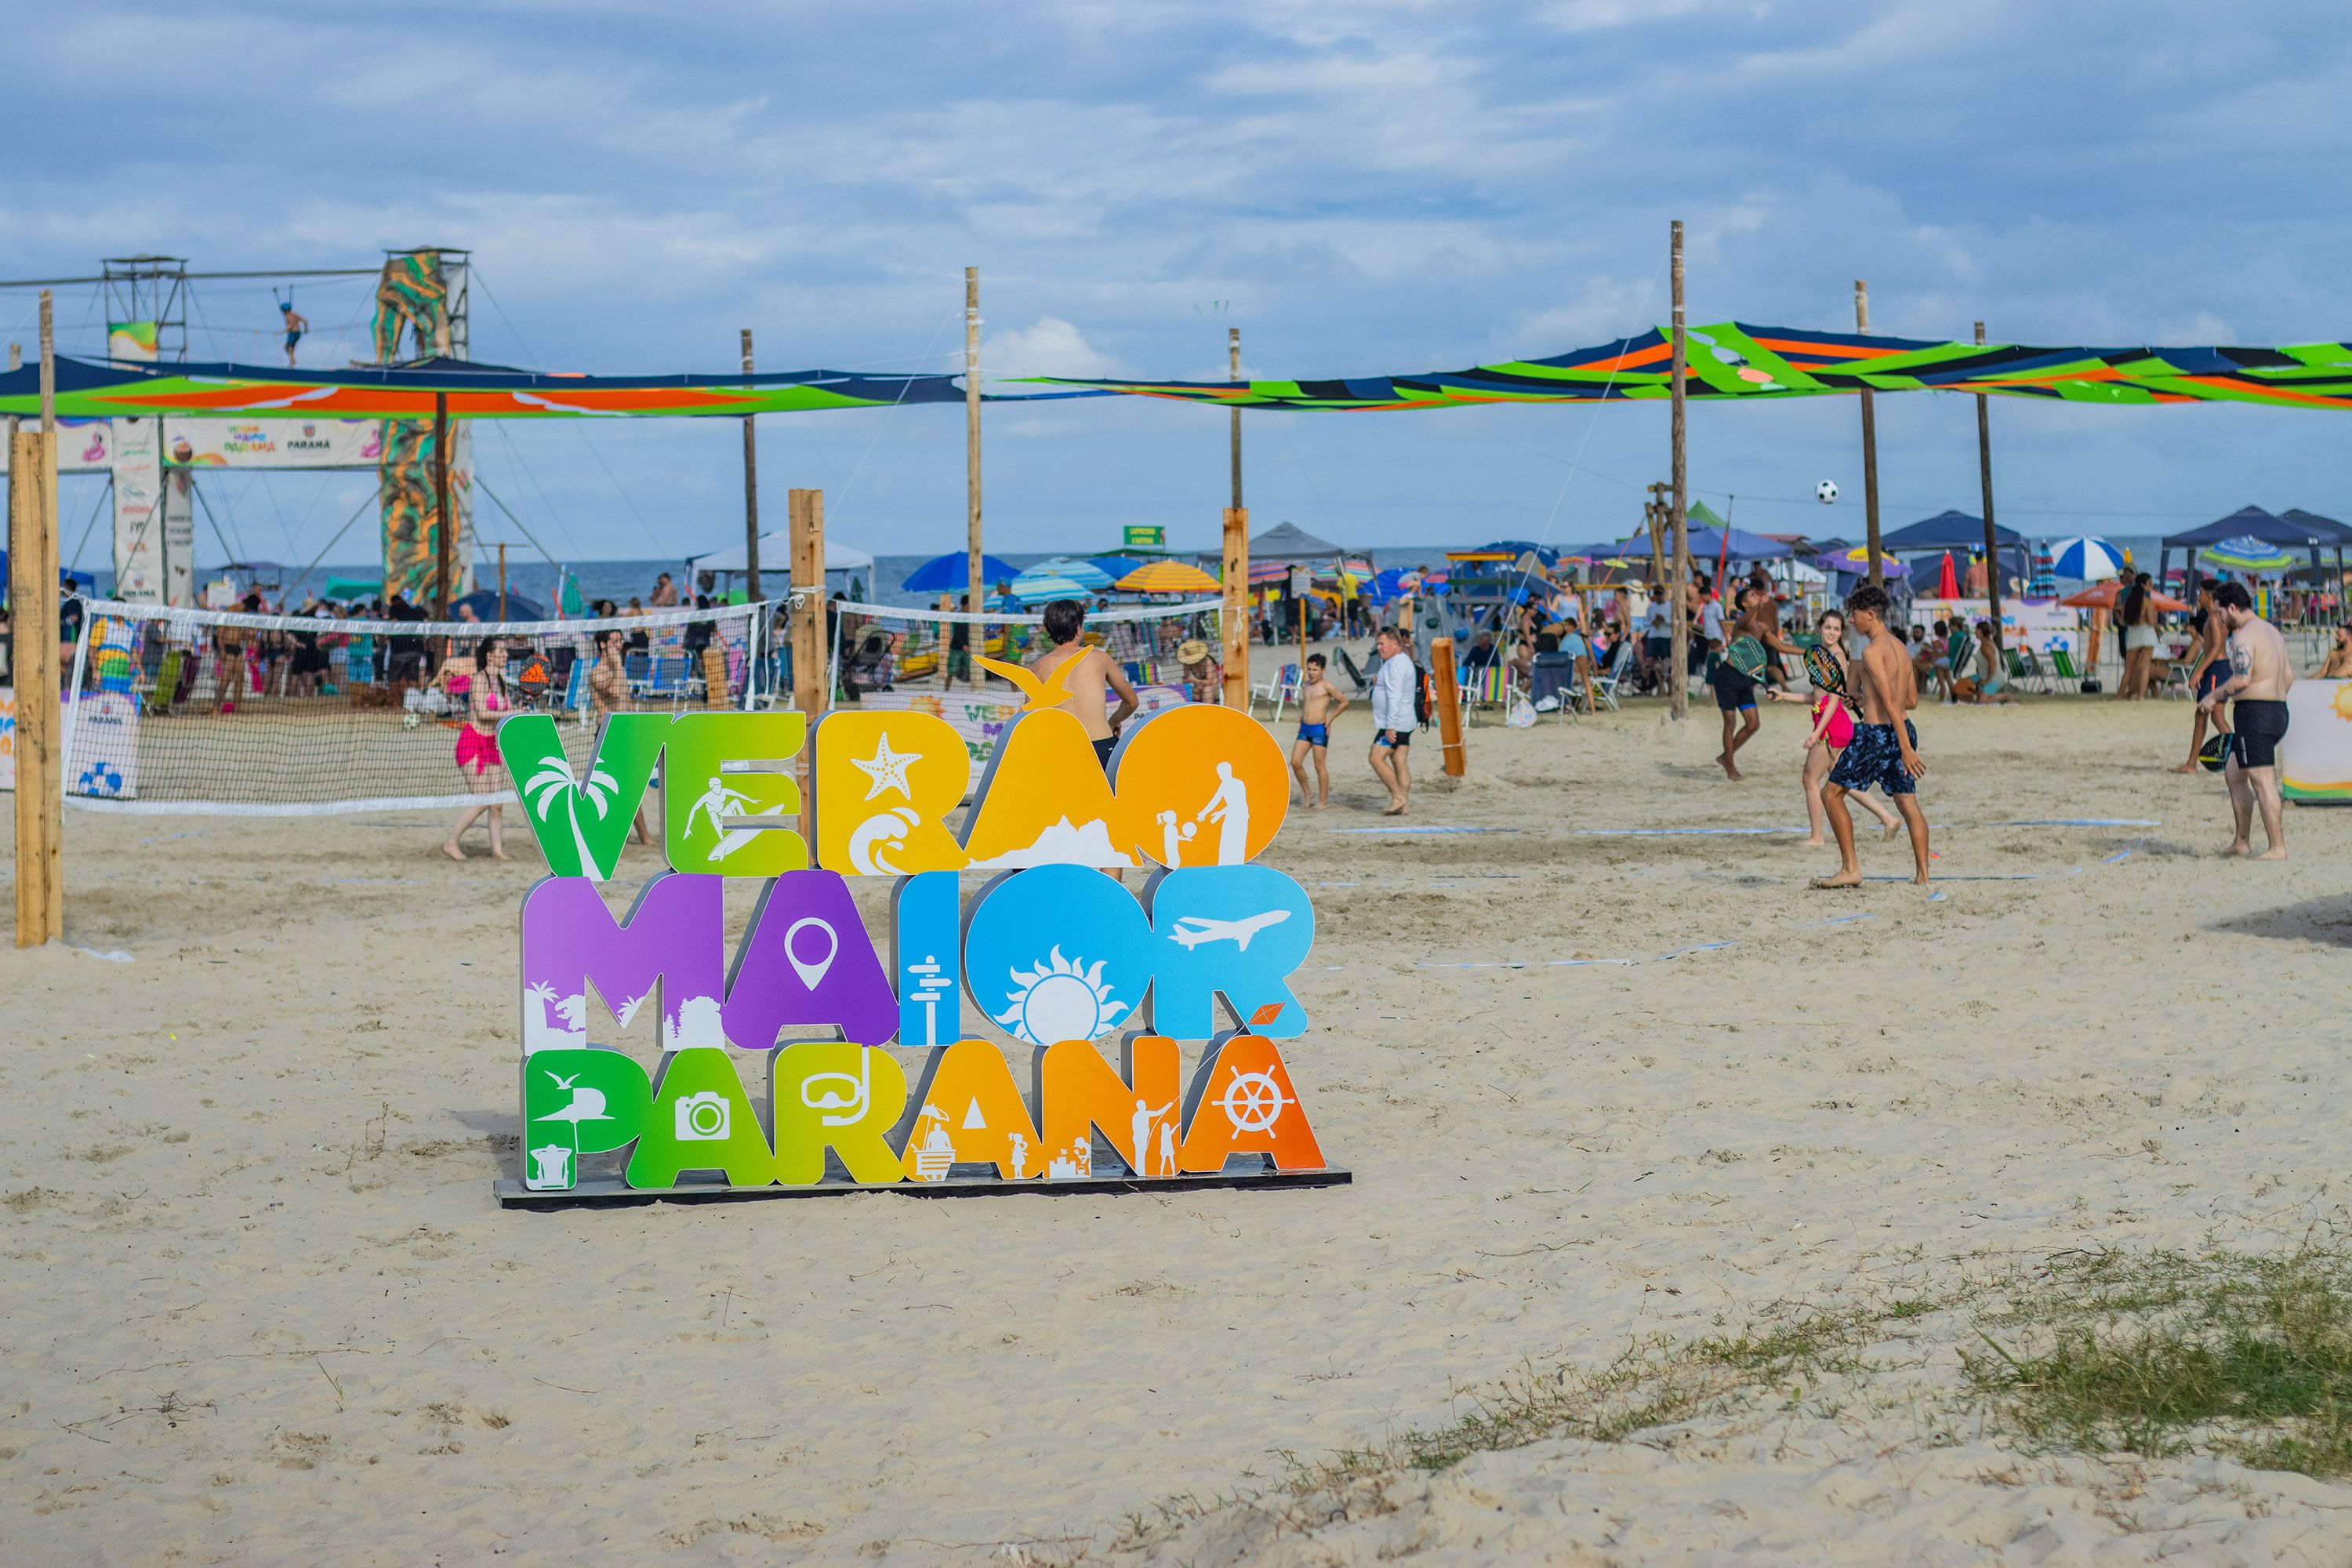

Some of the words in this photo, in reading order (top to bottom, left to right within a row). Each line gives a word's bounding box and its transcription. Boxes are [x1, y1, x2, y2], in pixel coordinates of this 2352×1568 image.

[287, 439, 330, 449] PARANÁ
[495, 652, 1291, 881] VERÃO
[520, 863, 1316, 1056] MAIOR
